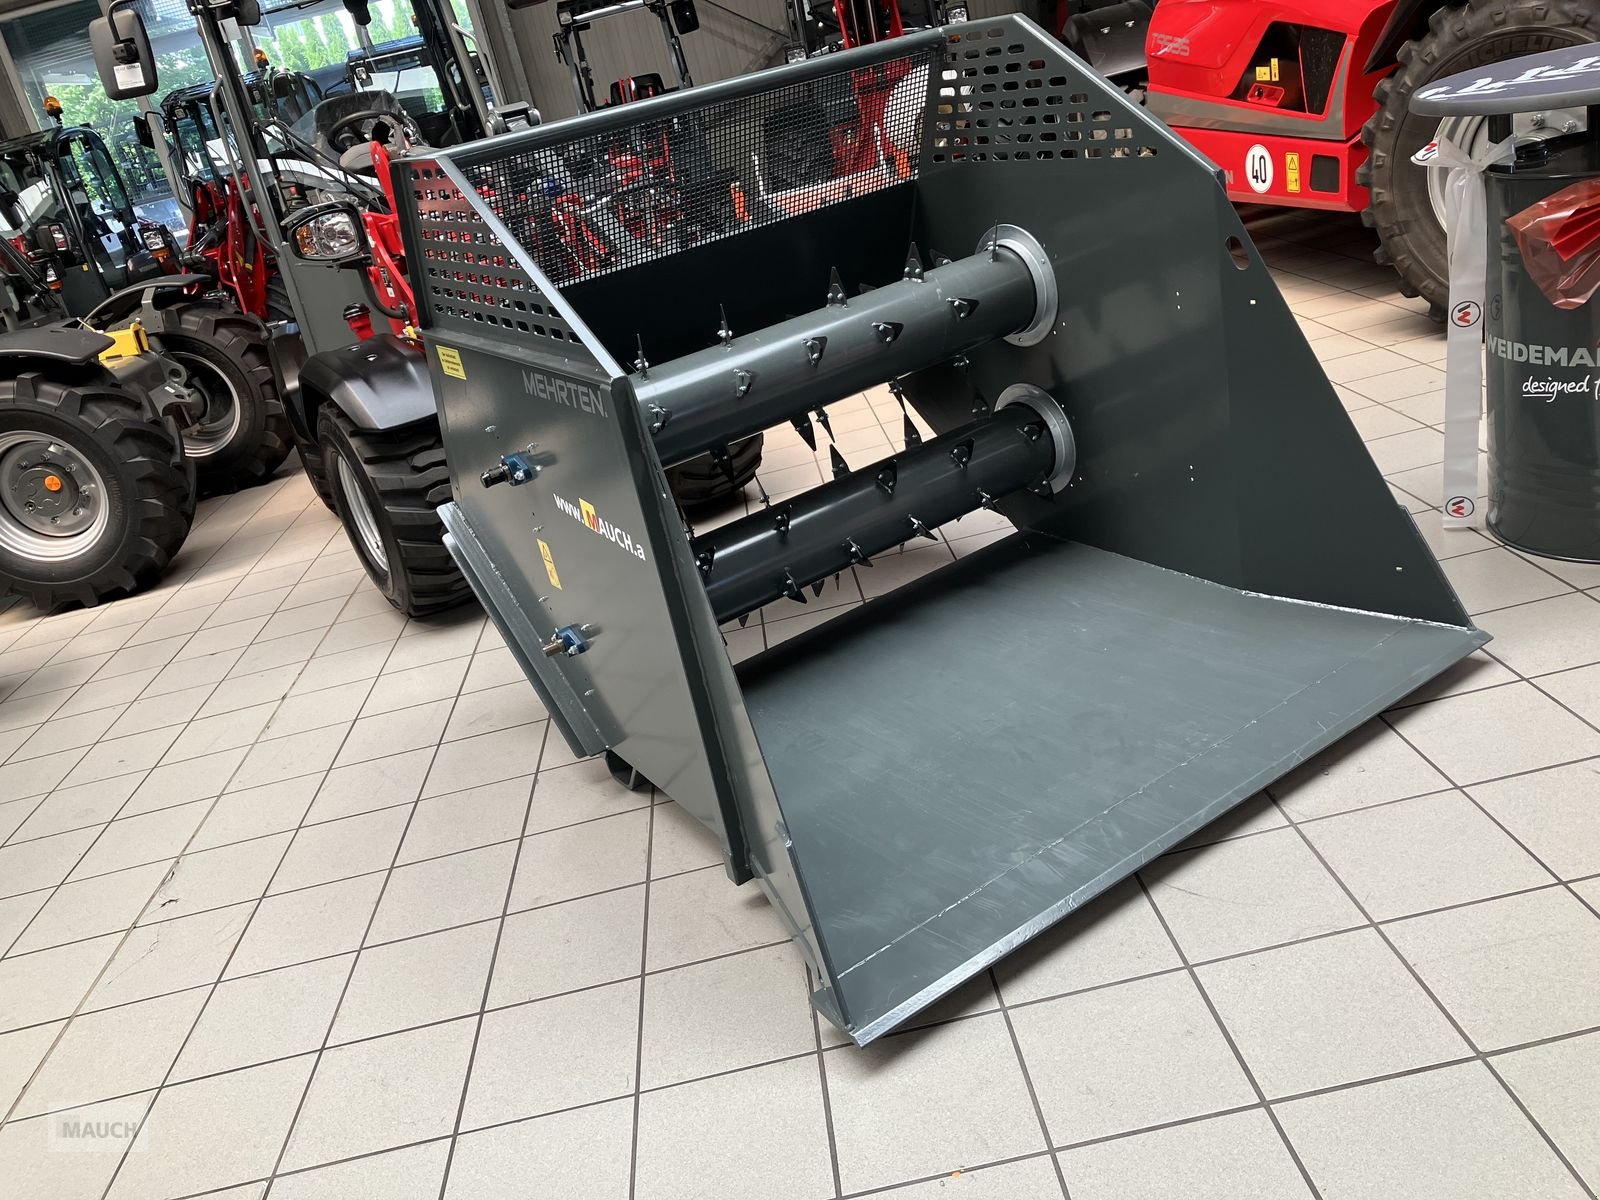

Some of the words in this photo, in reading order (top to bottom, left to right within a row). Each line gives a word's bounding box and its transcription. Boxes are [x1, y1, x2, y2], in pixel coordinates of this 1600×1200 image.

[1252, 154, 1267, 184] 40
[1487, 334, 1600, 367] WEIDEMA
[1522, 374, 1590, 403] designed
